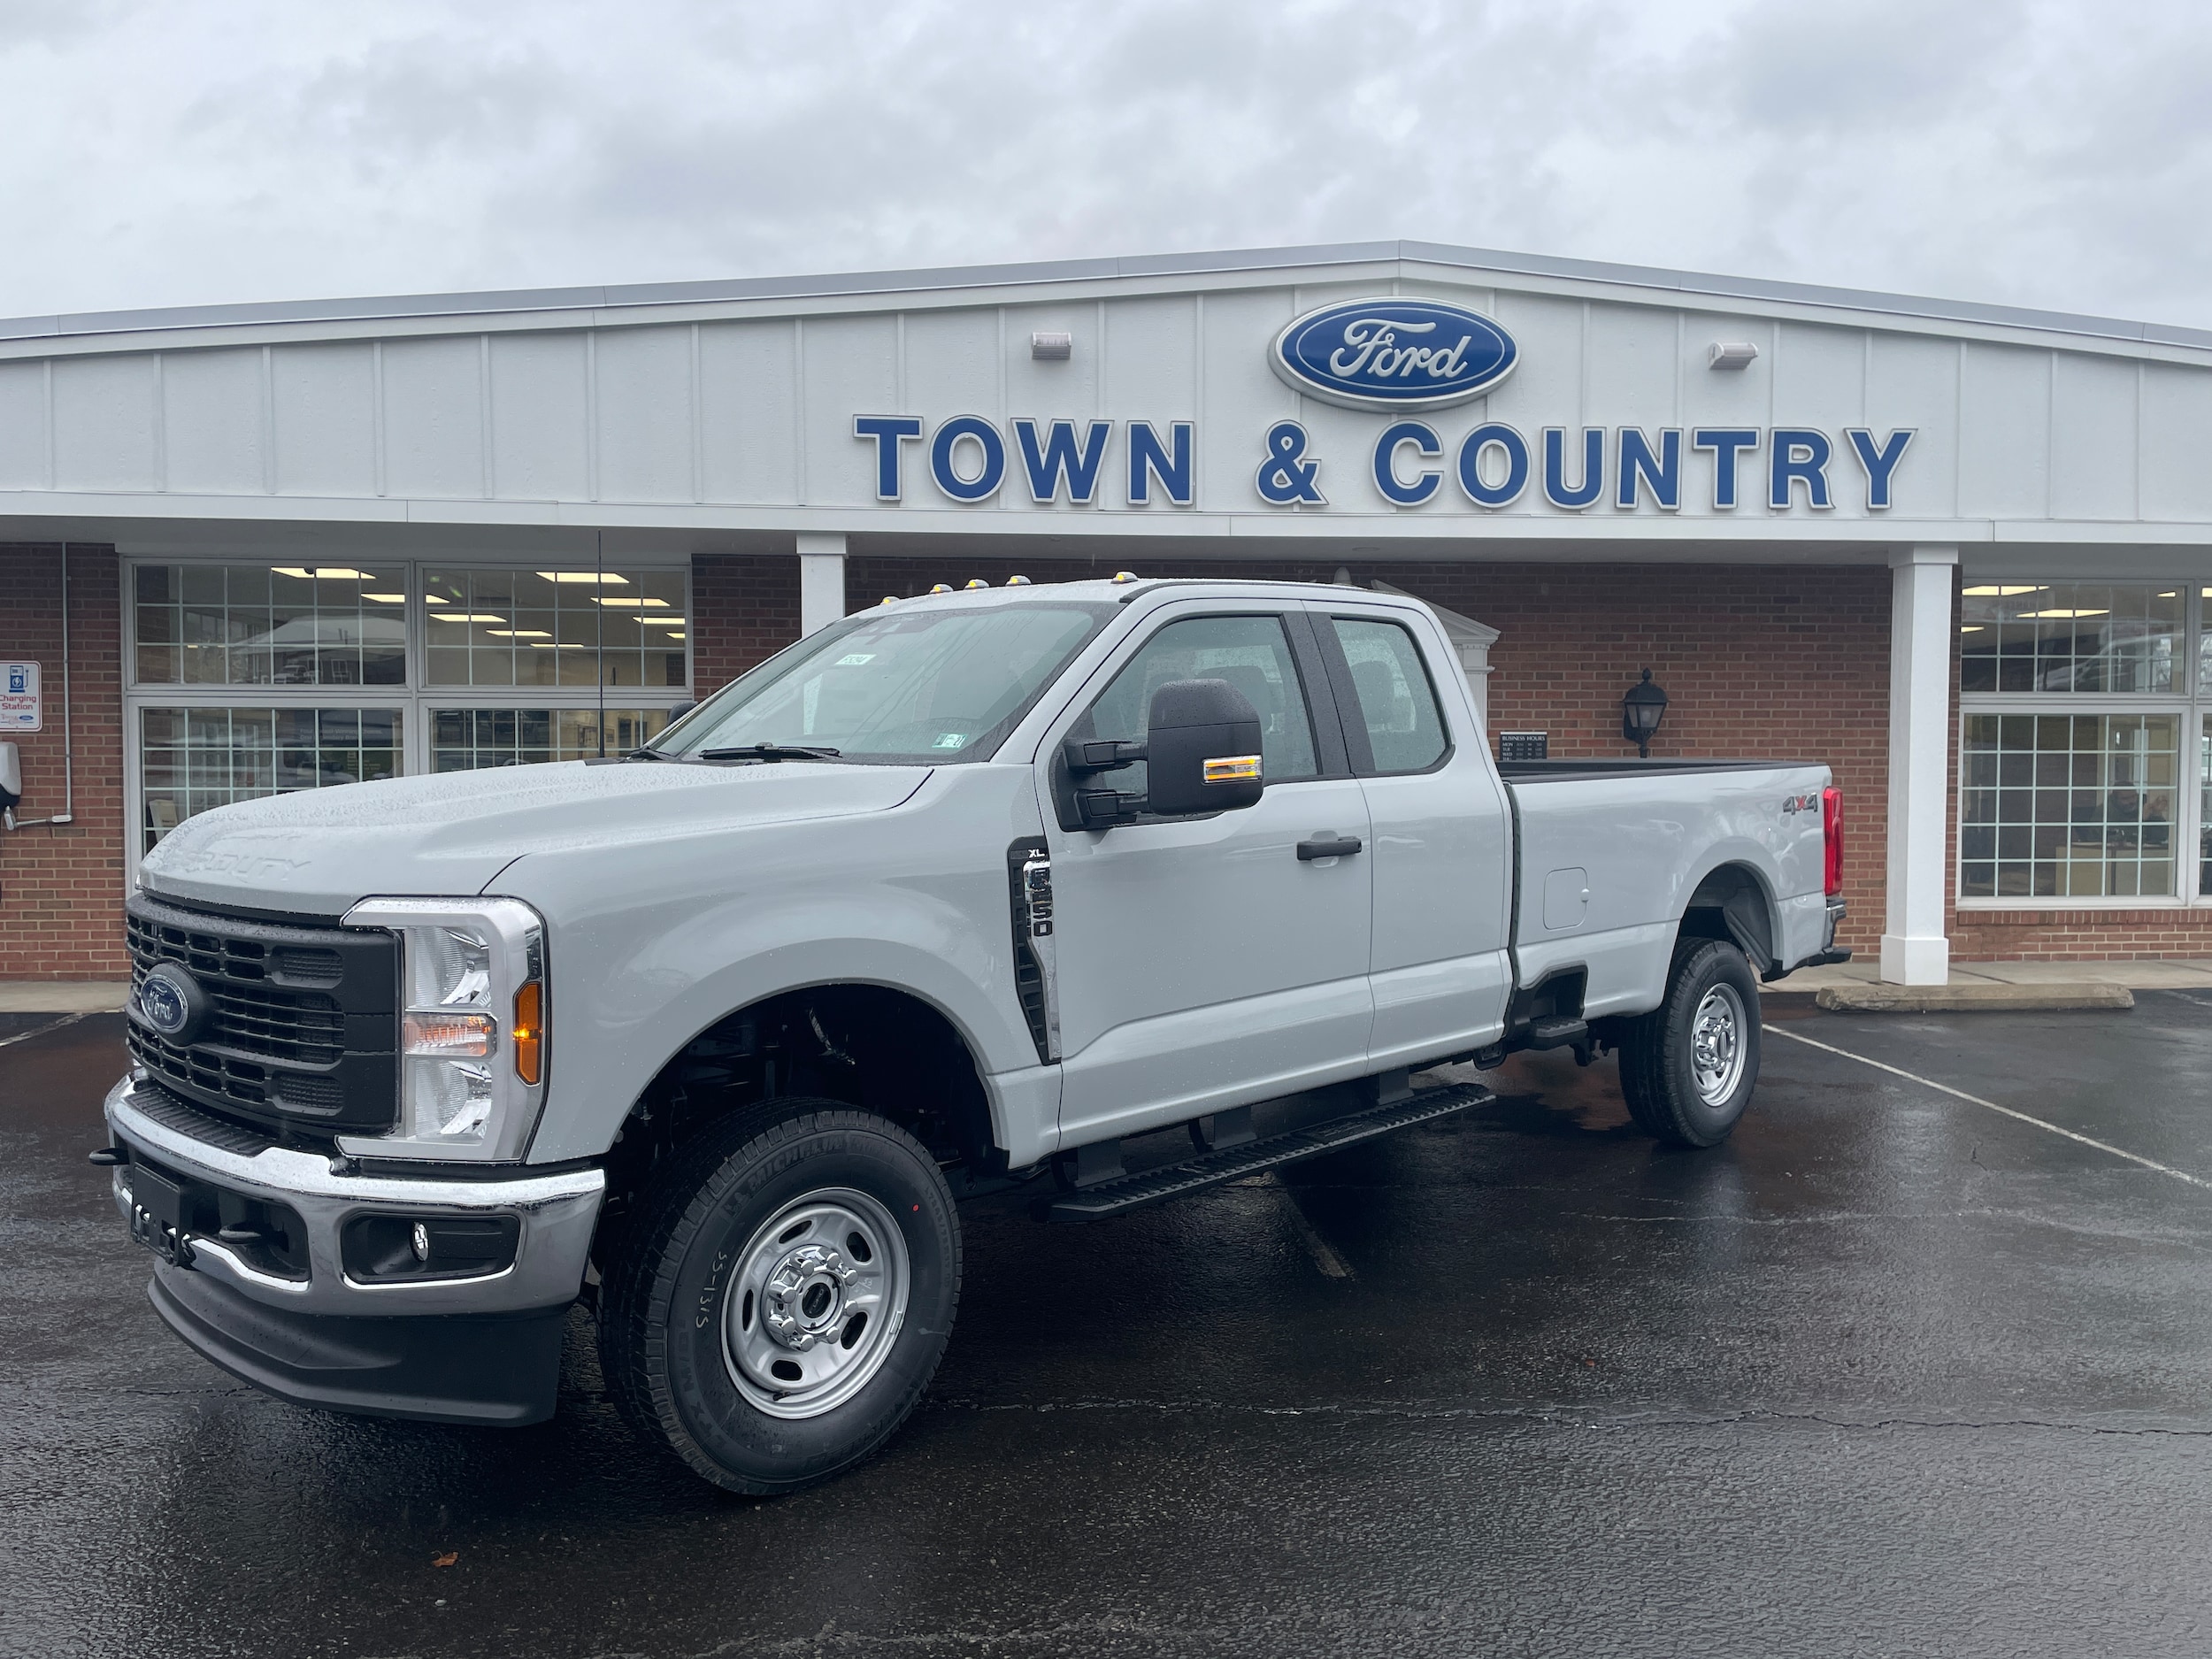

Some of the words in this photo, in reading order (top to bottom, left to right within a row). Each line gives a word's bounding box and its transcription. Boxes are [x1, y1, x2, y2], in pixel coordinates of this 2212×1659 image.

[1330, 319, 1472, 377] Ford
[853, 414, 1195, 505] TOWN
[1256, 419, 1328, 506] &
[1373, 419, 1918, 510] COUNTRY
[147, 985, 174, 1021] Ford
